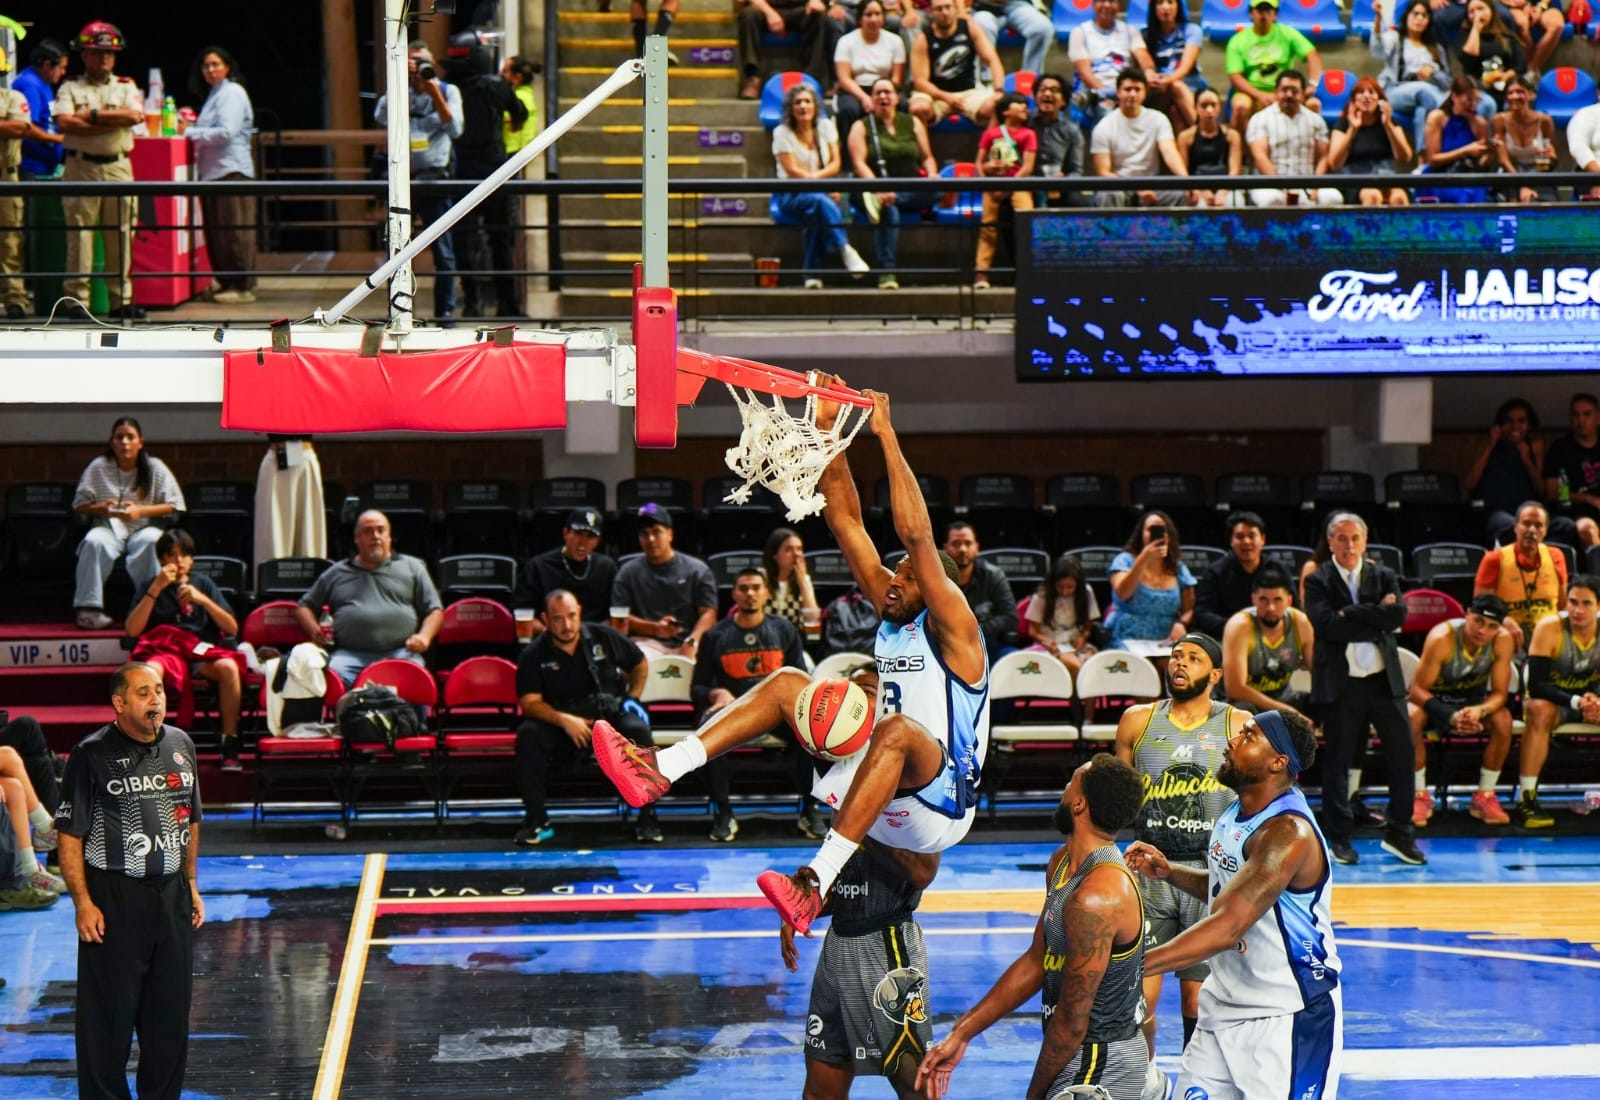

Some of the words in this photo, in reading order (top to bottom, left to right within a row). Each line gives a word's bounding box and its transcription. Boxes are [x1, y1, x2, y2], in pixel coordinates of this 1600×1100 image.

[1307, 269, 1427, 322] Ford
[1456, 306, 1535, 321] HACEMOS
[1539, 306, 1560, 320] LA
[10, 645, 40, 664] VIP
[58, 643, 90, 663] 105
[875, 655, 925, 673] TROS
[1166, 815, 1215, 833] Coppel
[389, 882, 698, 897] SANDOVAL
